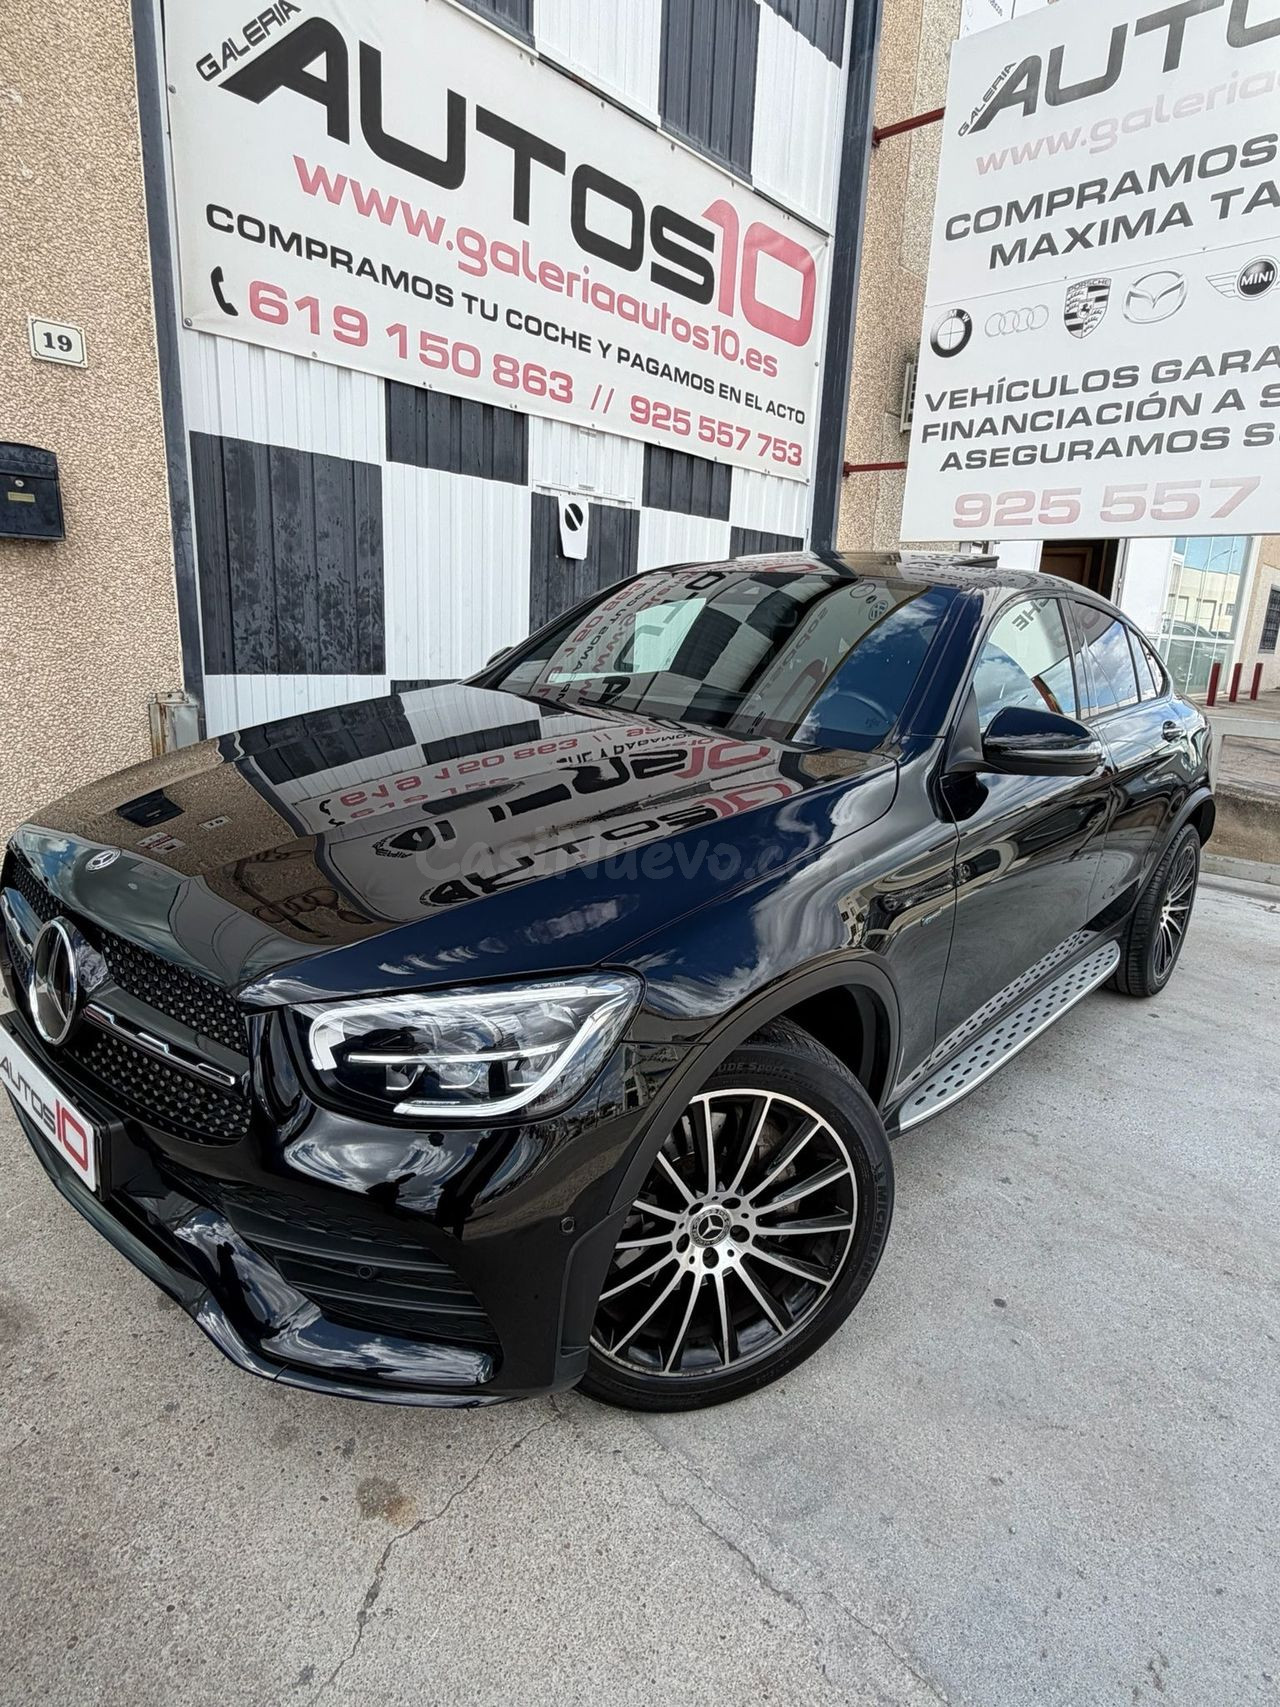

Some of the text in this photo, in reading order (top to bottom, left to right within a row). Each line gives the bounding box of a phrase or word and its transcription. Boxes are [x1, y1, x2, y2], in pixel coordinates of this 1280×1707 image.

[195, 0, 301, 82] GALERIA
[957, 62, 1017, 138] GALERIA
[975, 69, 1280, 176] www.galeria
[217, 16, 817, 348] AUTOS10
[945, 132, 1279, 242] COMPRAMOS
[292, 154, 778, 379] www.galeriaautos10.es
[988, 201, 1194, 270] MAXIMA
[205, 203, 806, 425] COMPRAMOS TU COCHE Y PAGAMOS EN EL ACTO
[1240, 270, 1274, 287] MINI
[43, 331, 73, 353] 19
[249, 280, 369, 347] 619
[385, 323, 481, 378] 150
[492, 353, 573, 404] 863
[629, 395, 691, 436] 925
[698, 415, 751, 451] 557
[757, 432, 803, 467] 753
[921, 390, 1203, 444] FINANCIACIÓN
[1211, 388, 1246, 414] A
[924, 364, 1140, 413] VEHÍCULOS
[939, 426, 1231, 473] ASEGURAMOS
[953, 475, 1262, 528] 925 557
[0, 1056, 89, 1172] AUTOS10
